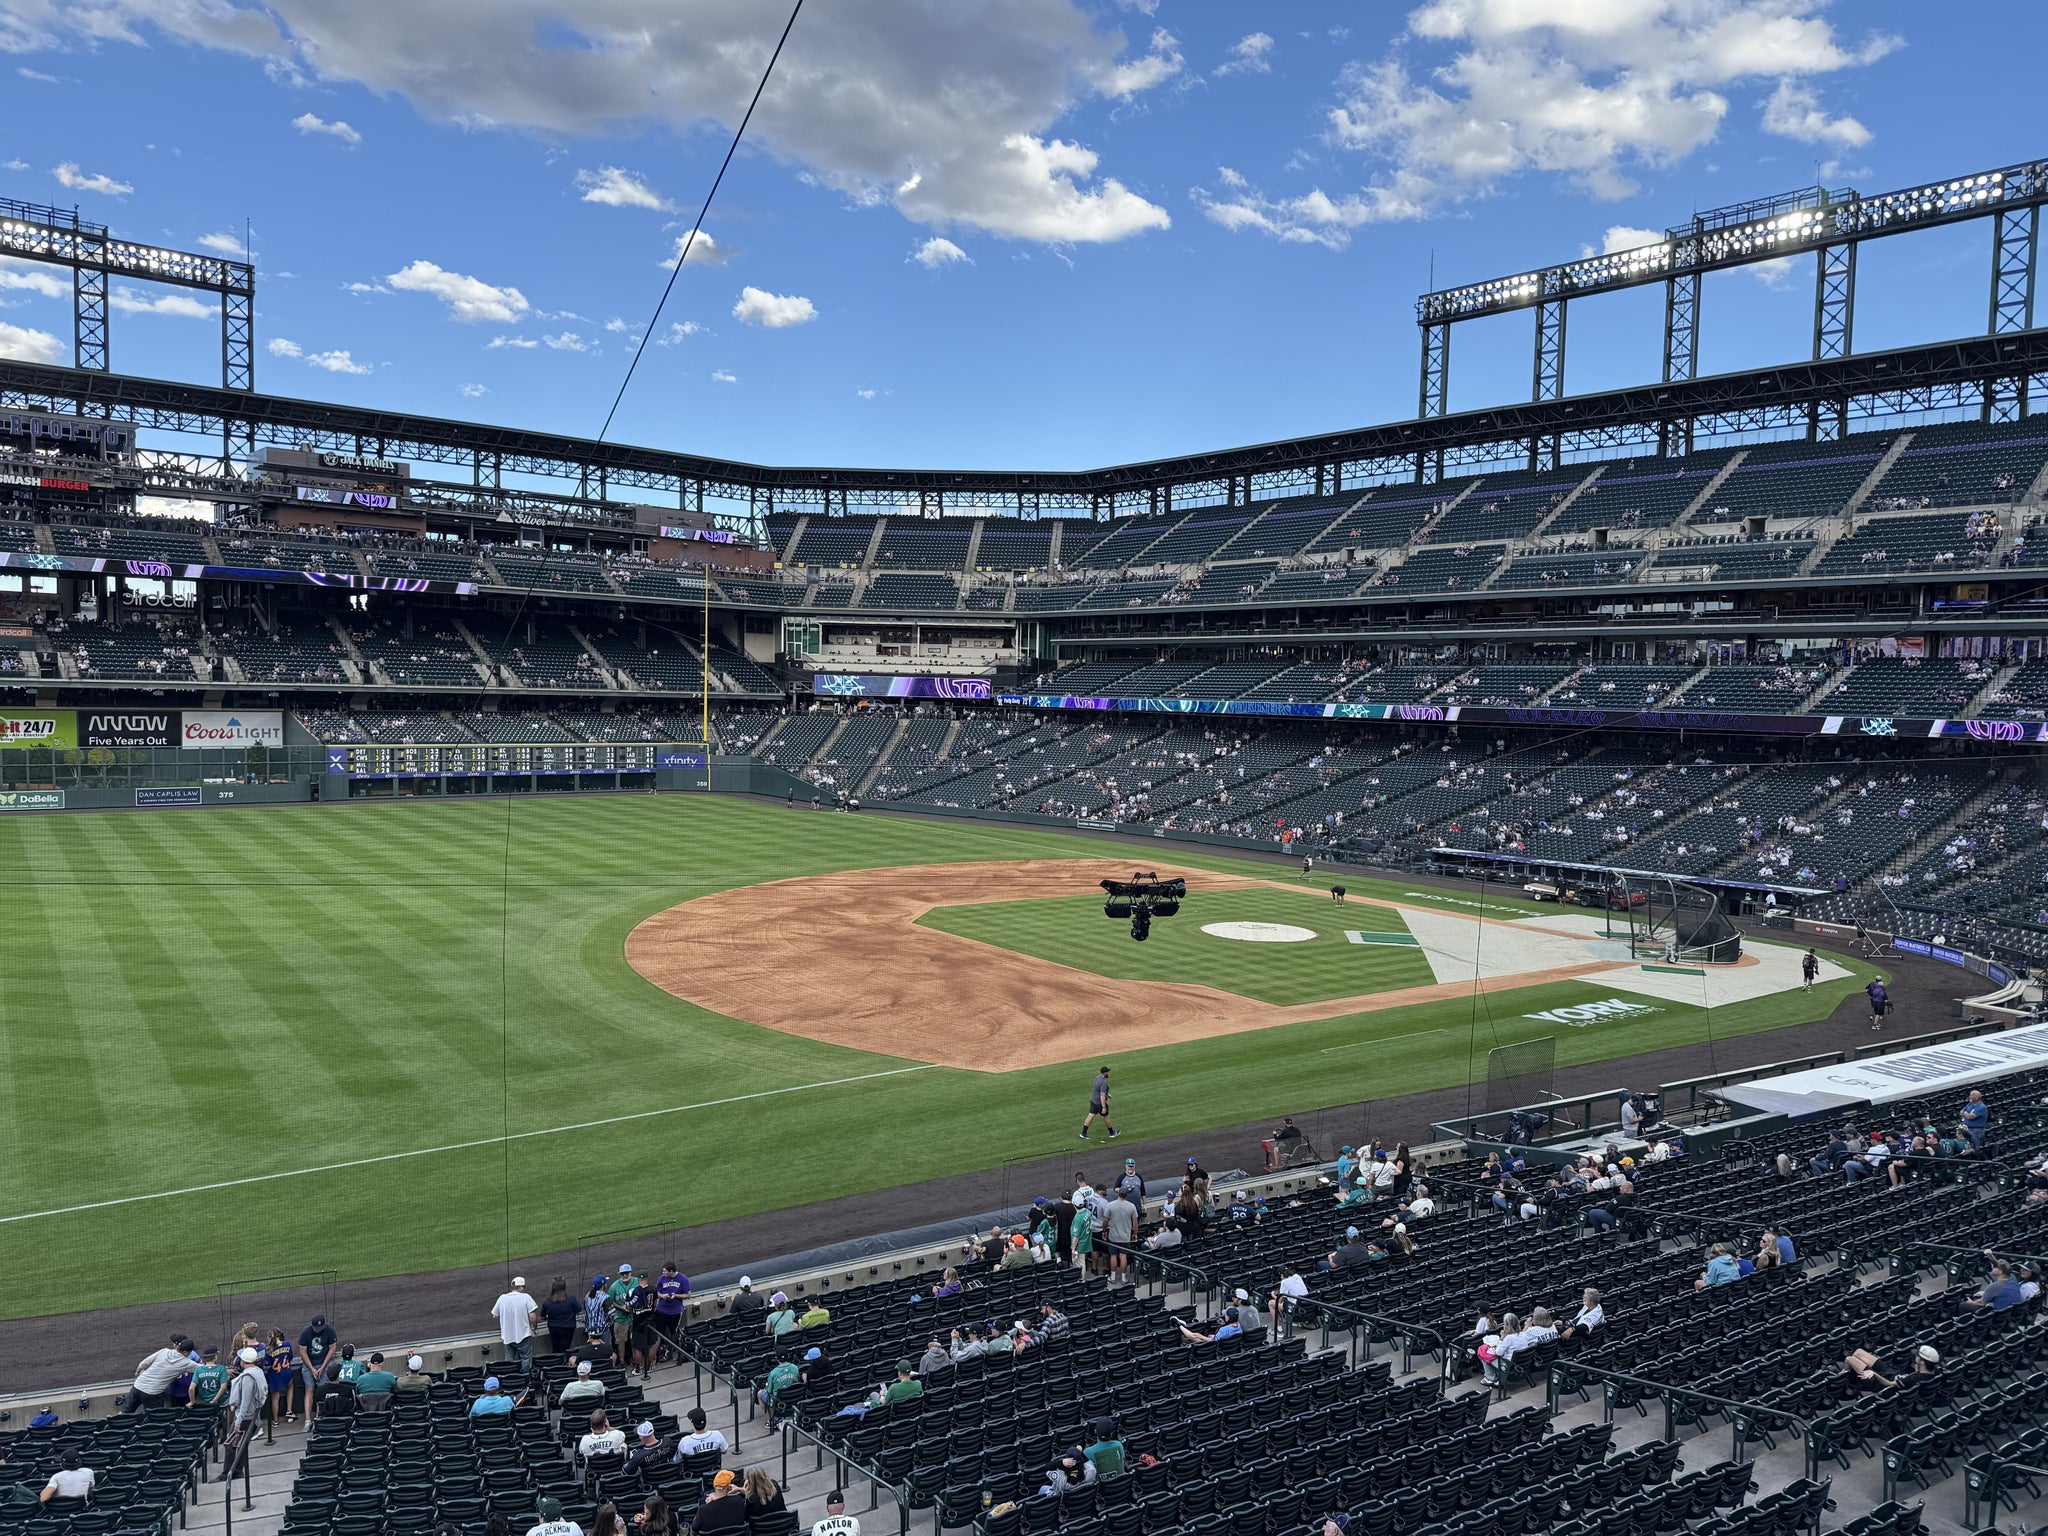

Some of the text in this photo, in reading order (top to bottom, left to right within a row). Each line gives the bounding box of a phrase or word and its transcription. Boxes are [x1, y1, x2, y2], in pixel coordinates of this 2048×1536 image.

[10, 415, 136, 449] ROOFTOP
[340, 454, 362, 466] JACK
[514, 513, 546, 526] Silver
[23, 721, 54, 733] 24/7
[88, 715, 167, 731] ARROW
[185, 722, 281, 740] Coors LIGHT
[88, 736, 168, 745] Five Years Out
[664, 755, 698, 768] xfinity
[20, 795, 59, 803] DaBella
[156, 790, 181, 798] CAPLIS
[1520, 998, 1650, 1023] YORK
[1856, 1049, 2006, 1083] BASEBALL
[271, 1355, 290, 1373] 44
[339, 1367, 353, 1380] 44
[201, 1379, 217, 1389] 44
[589, 1440, 614, 1450] GRIFFEY
[692, 1441, 714, 1452] MILLER
[820, 1519, 852, 1533] NAYLOR
